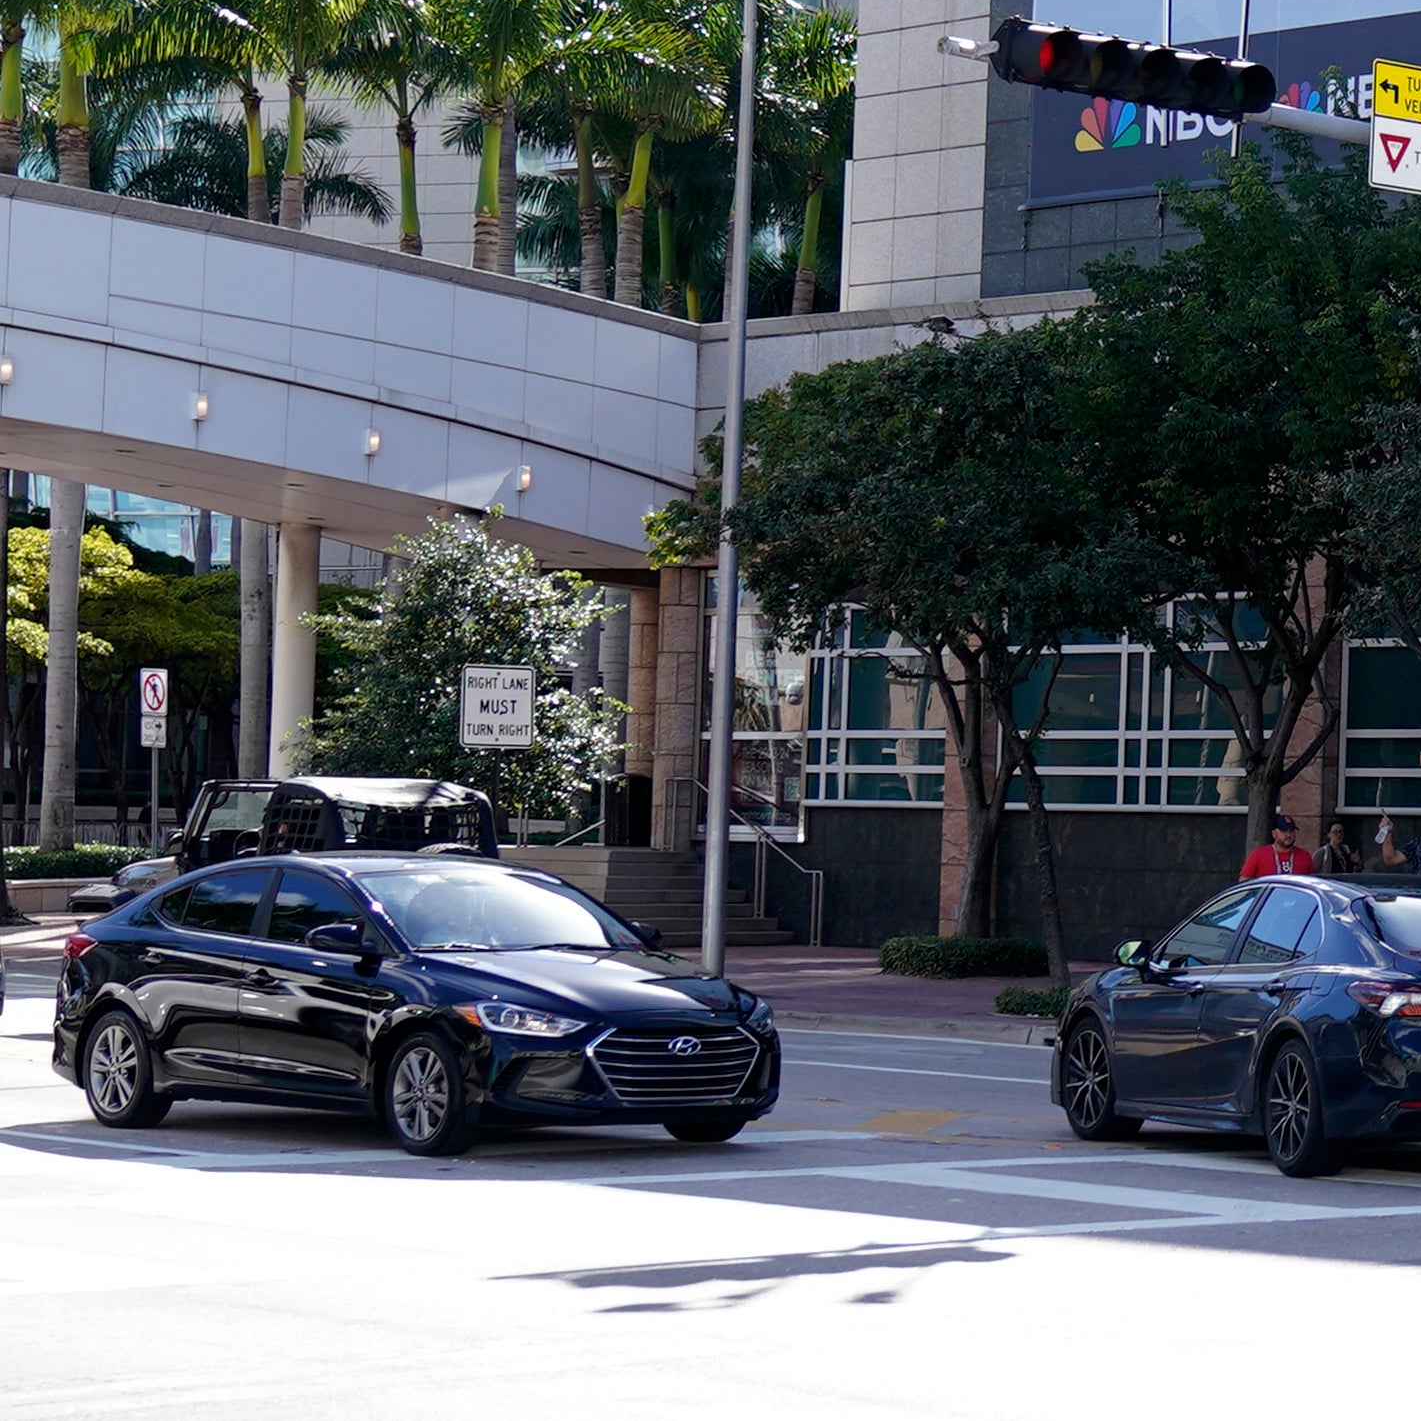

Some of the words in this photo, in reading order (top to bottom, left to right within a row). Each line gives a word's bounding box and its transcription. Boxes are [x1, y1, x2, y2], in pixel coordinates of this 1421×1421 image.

[467, 676, 498, 690] RIGHT
[502, 677, 529, 691] LANE
[479, 699, 518, 715] MUST
[466, 723, 494, 737] TURN
[499, 724, 530, 737] RIGHT
